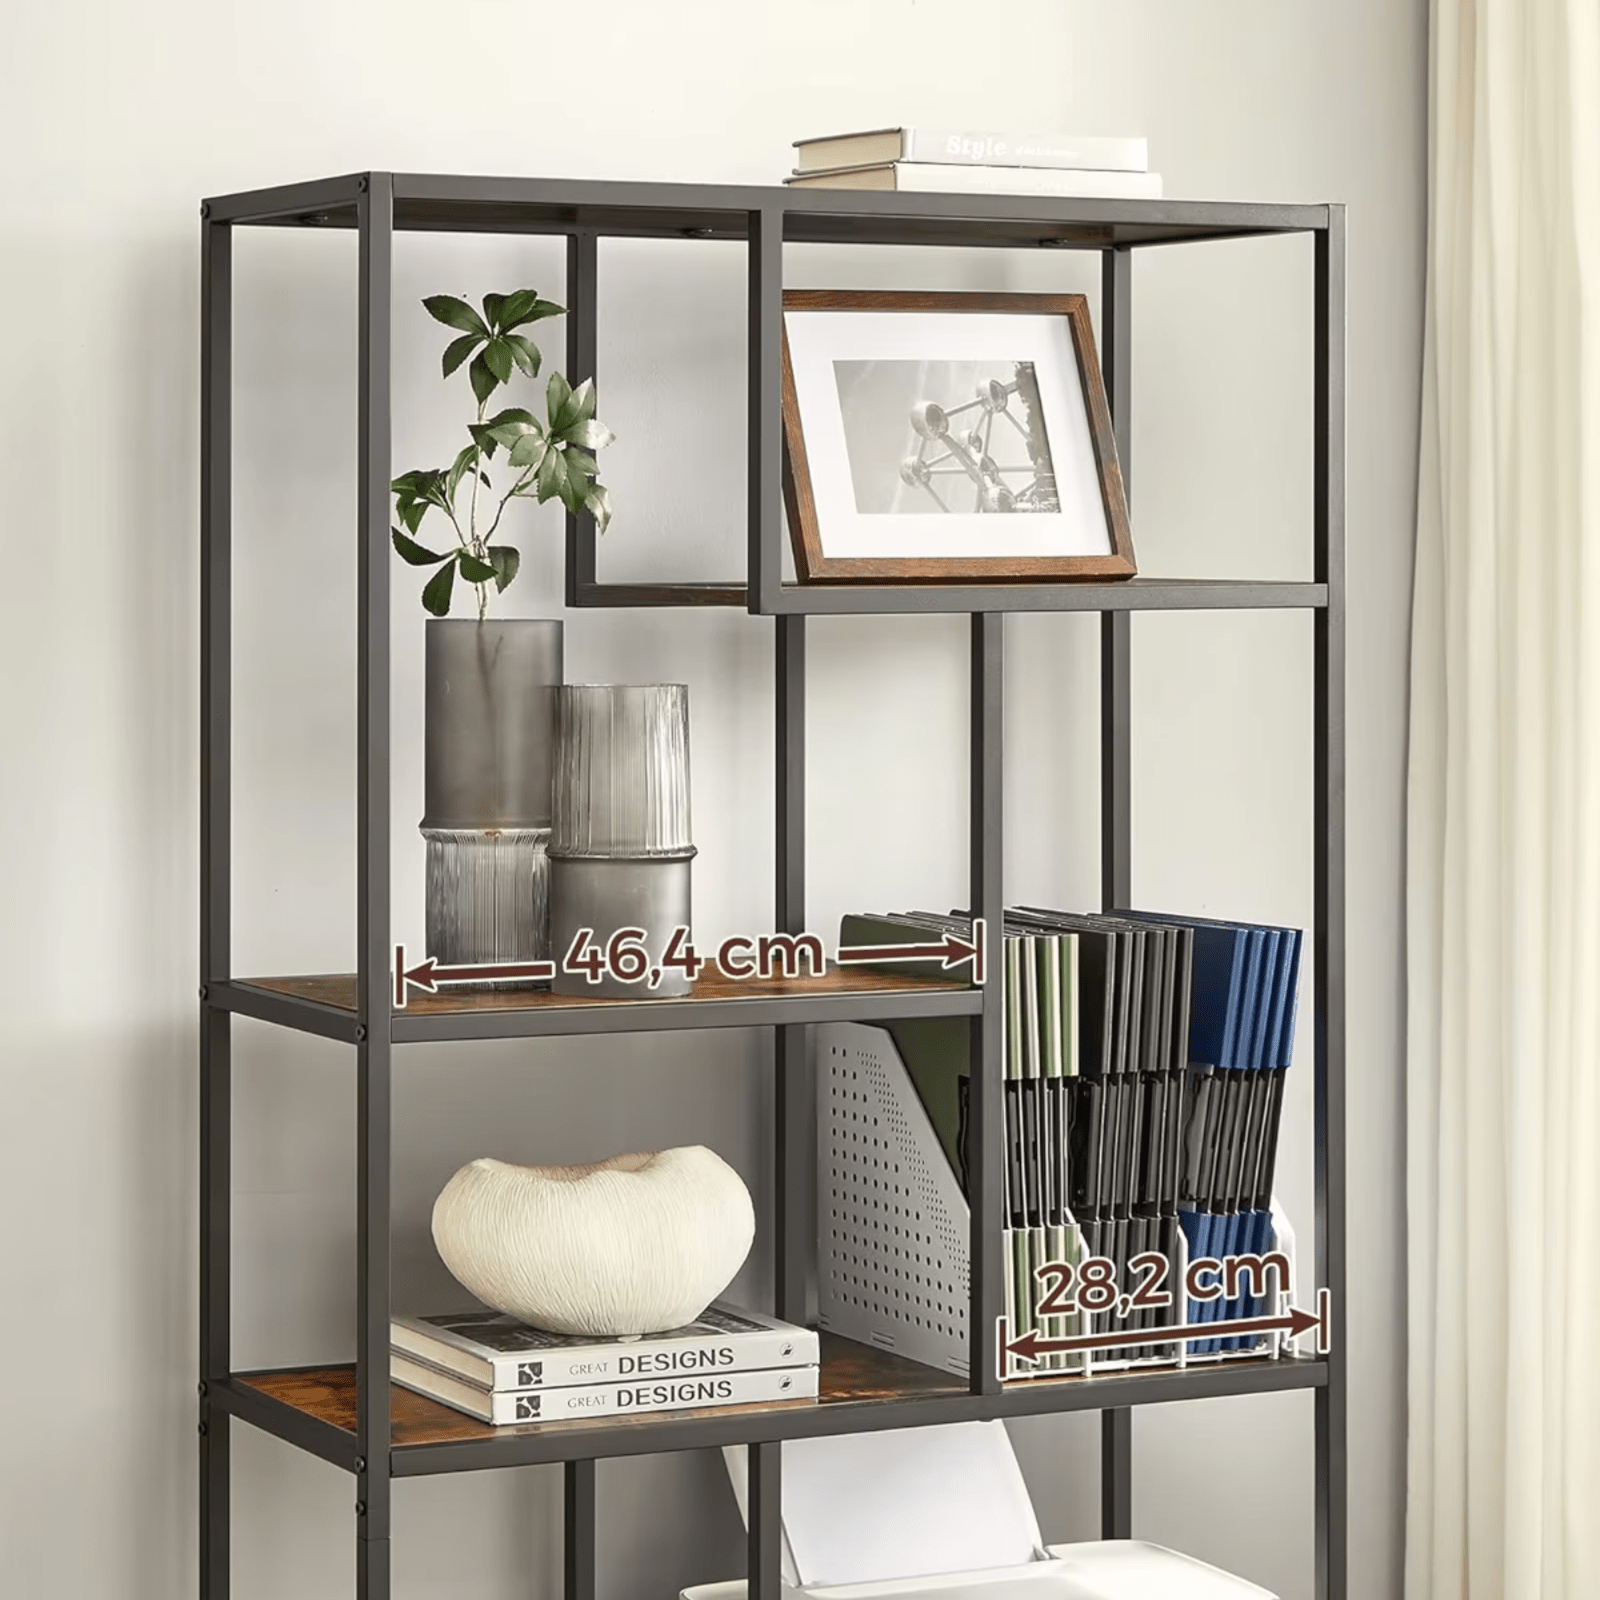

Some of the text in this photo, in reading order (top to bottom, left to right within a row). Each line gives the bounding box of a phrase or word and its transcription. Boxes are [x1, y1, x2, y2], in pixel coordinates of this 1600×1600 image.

[946, 134, 1008, 160] Style
[569, 1347, 735, 1376] GREAT DESIGNS
[567, 1380, 733, 1409] GREAT DESIGNS
